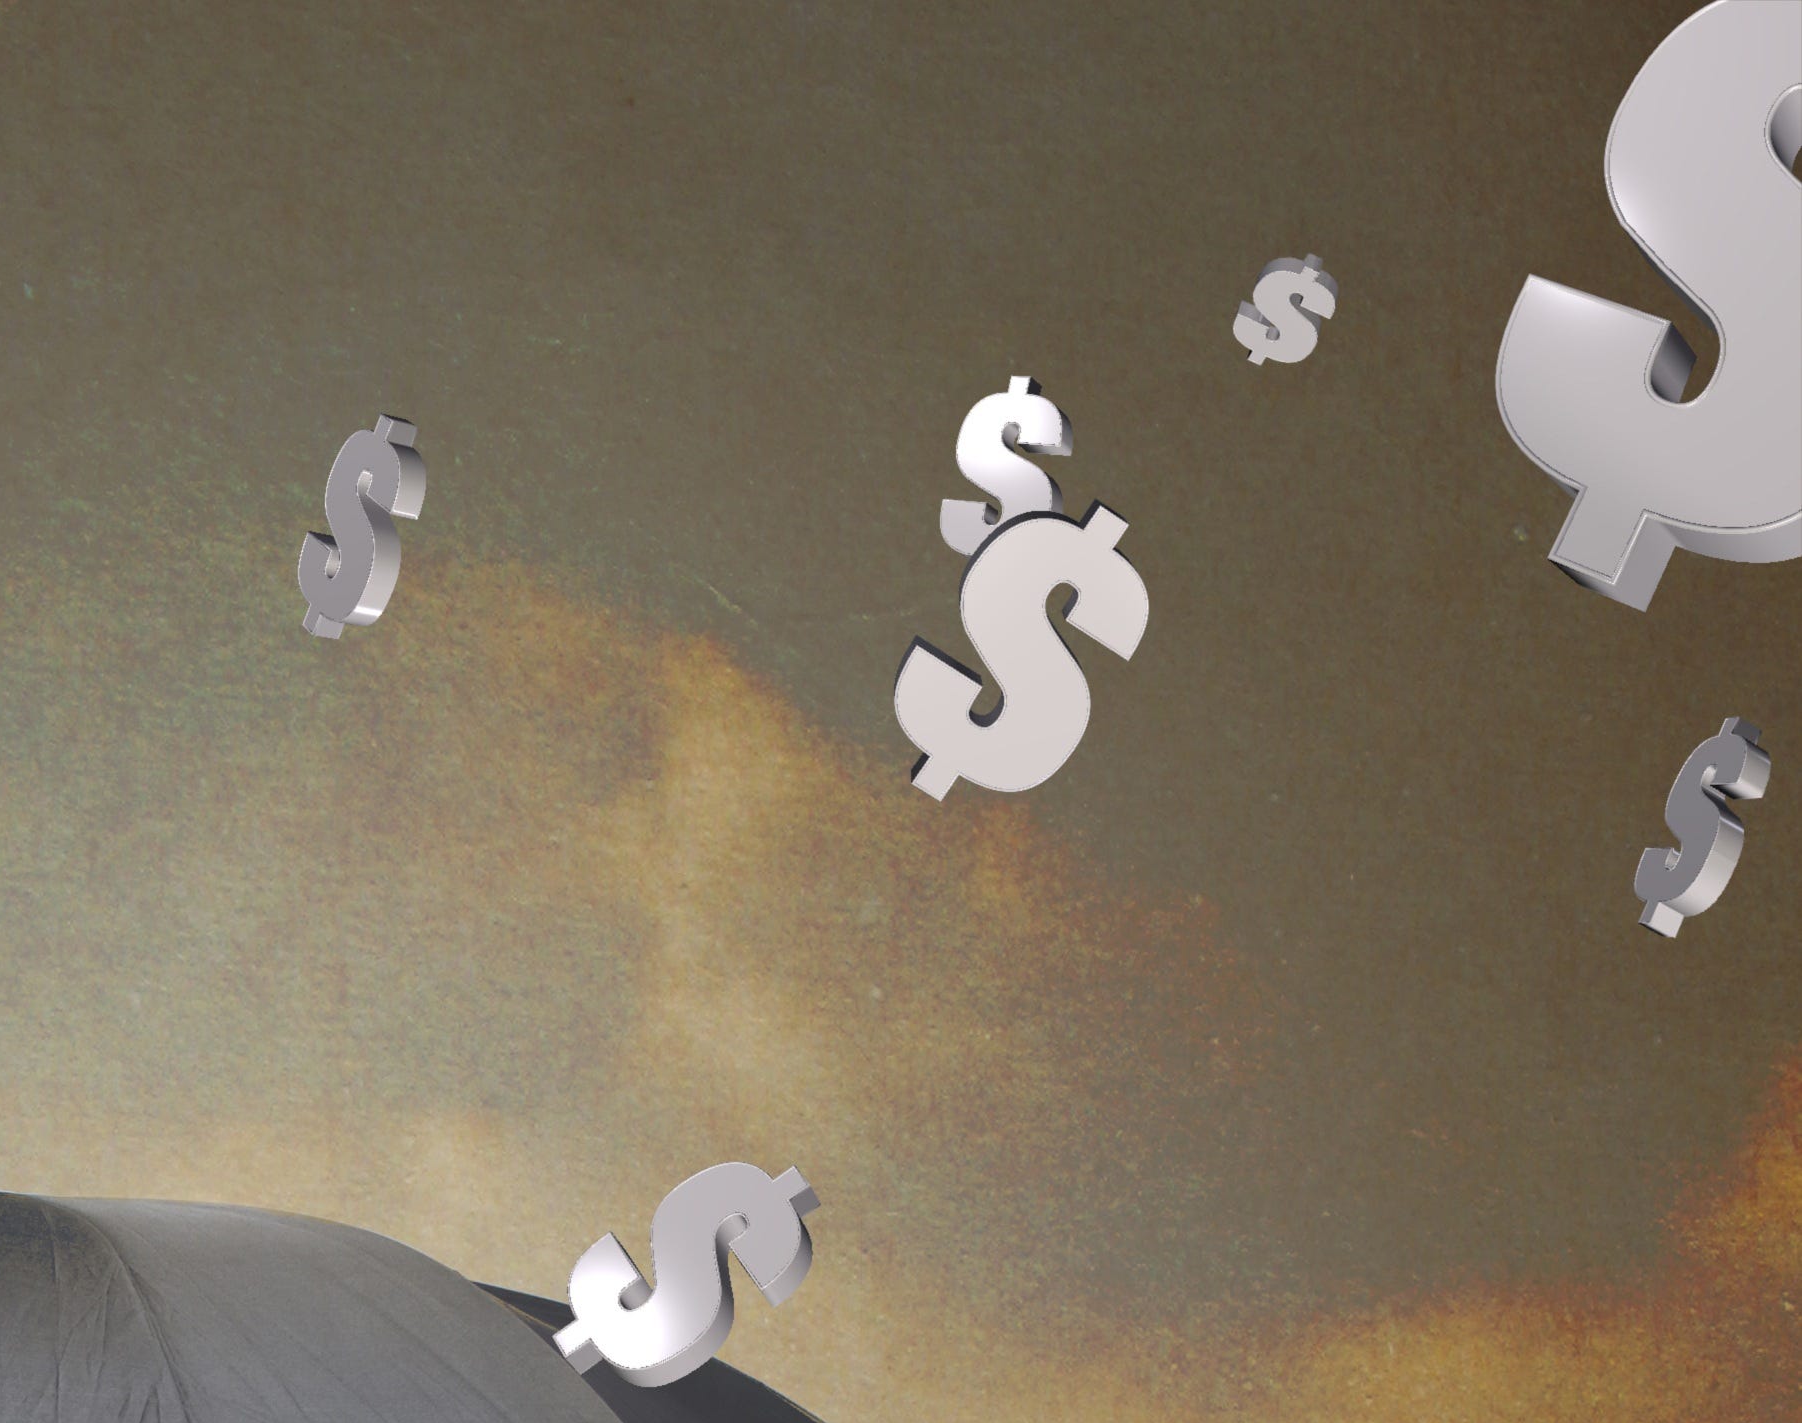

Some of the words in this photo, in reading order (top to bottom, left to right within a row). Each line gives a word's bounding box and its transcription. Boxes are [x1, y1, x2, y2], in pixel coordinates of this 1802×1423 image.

[1233, 254, 1338, 365] $
[298, 414, 426, 640] $
[940, 376, 1073, 557] $
[894, 500, 1149, 801] $
[1633, 717, 1771, 938] $
[553, 1162, 820, 1388] $
